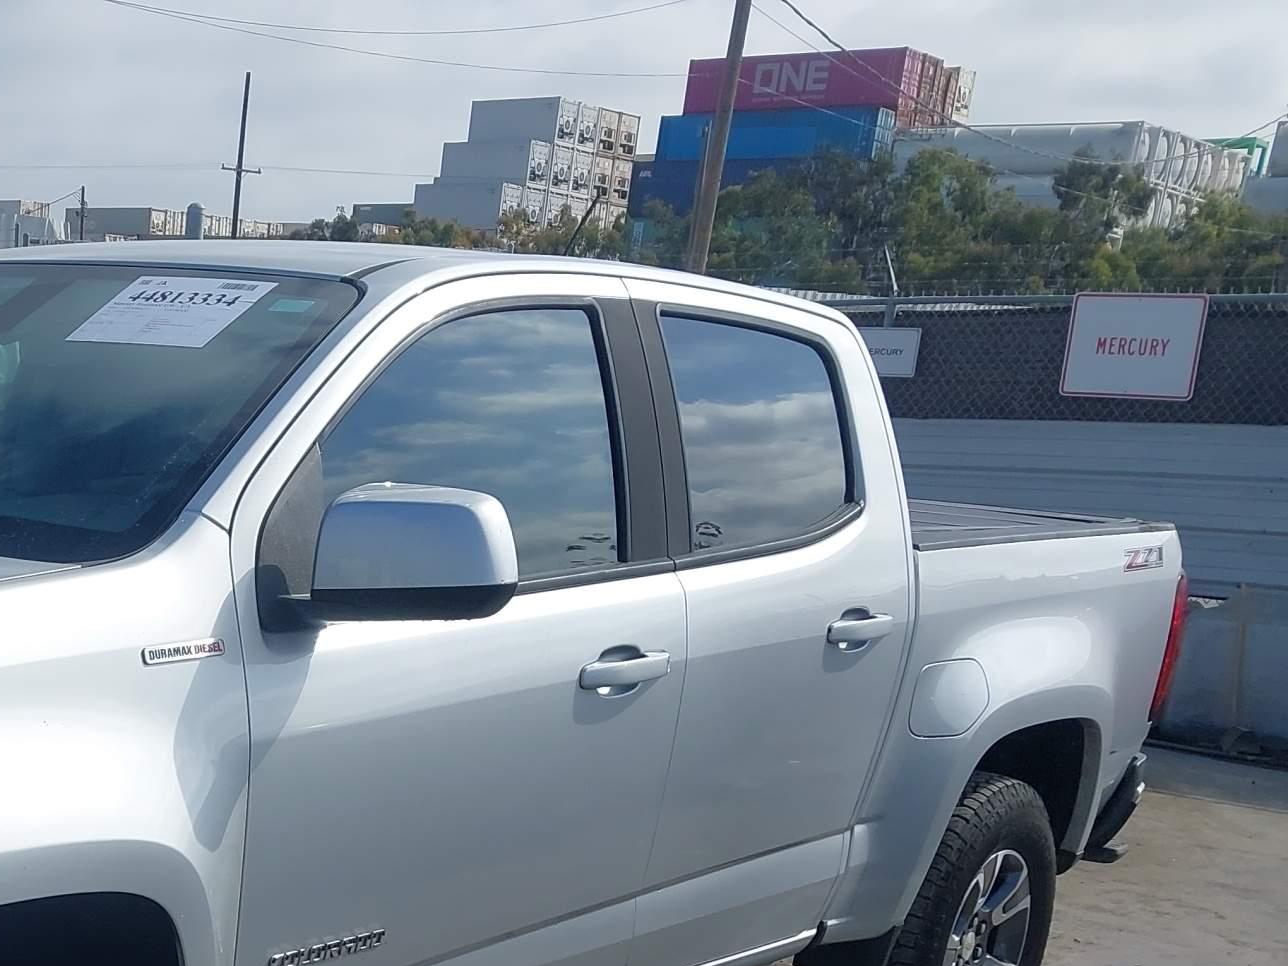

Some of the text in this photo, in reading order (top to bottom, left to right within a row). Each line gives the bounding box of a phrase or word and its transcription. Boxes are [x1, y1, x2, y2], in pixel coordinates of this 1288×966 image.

[752, 60, 830, 95] ONE
[128, 290, 242, 307] 44813334
[869, 347, 904, 356] ERCURY
[1096, 336, 1171, 357] MERCURY
[1124, 545, 1163, 572] Z71
[148, 641, 223, 660] DURAMAX DIESEL
